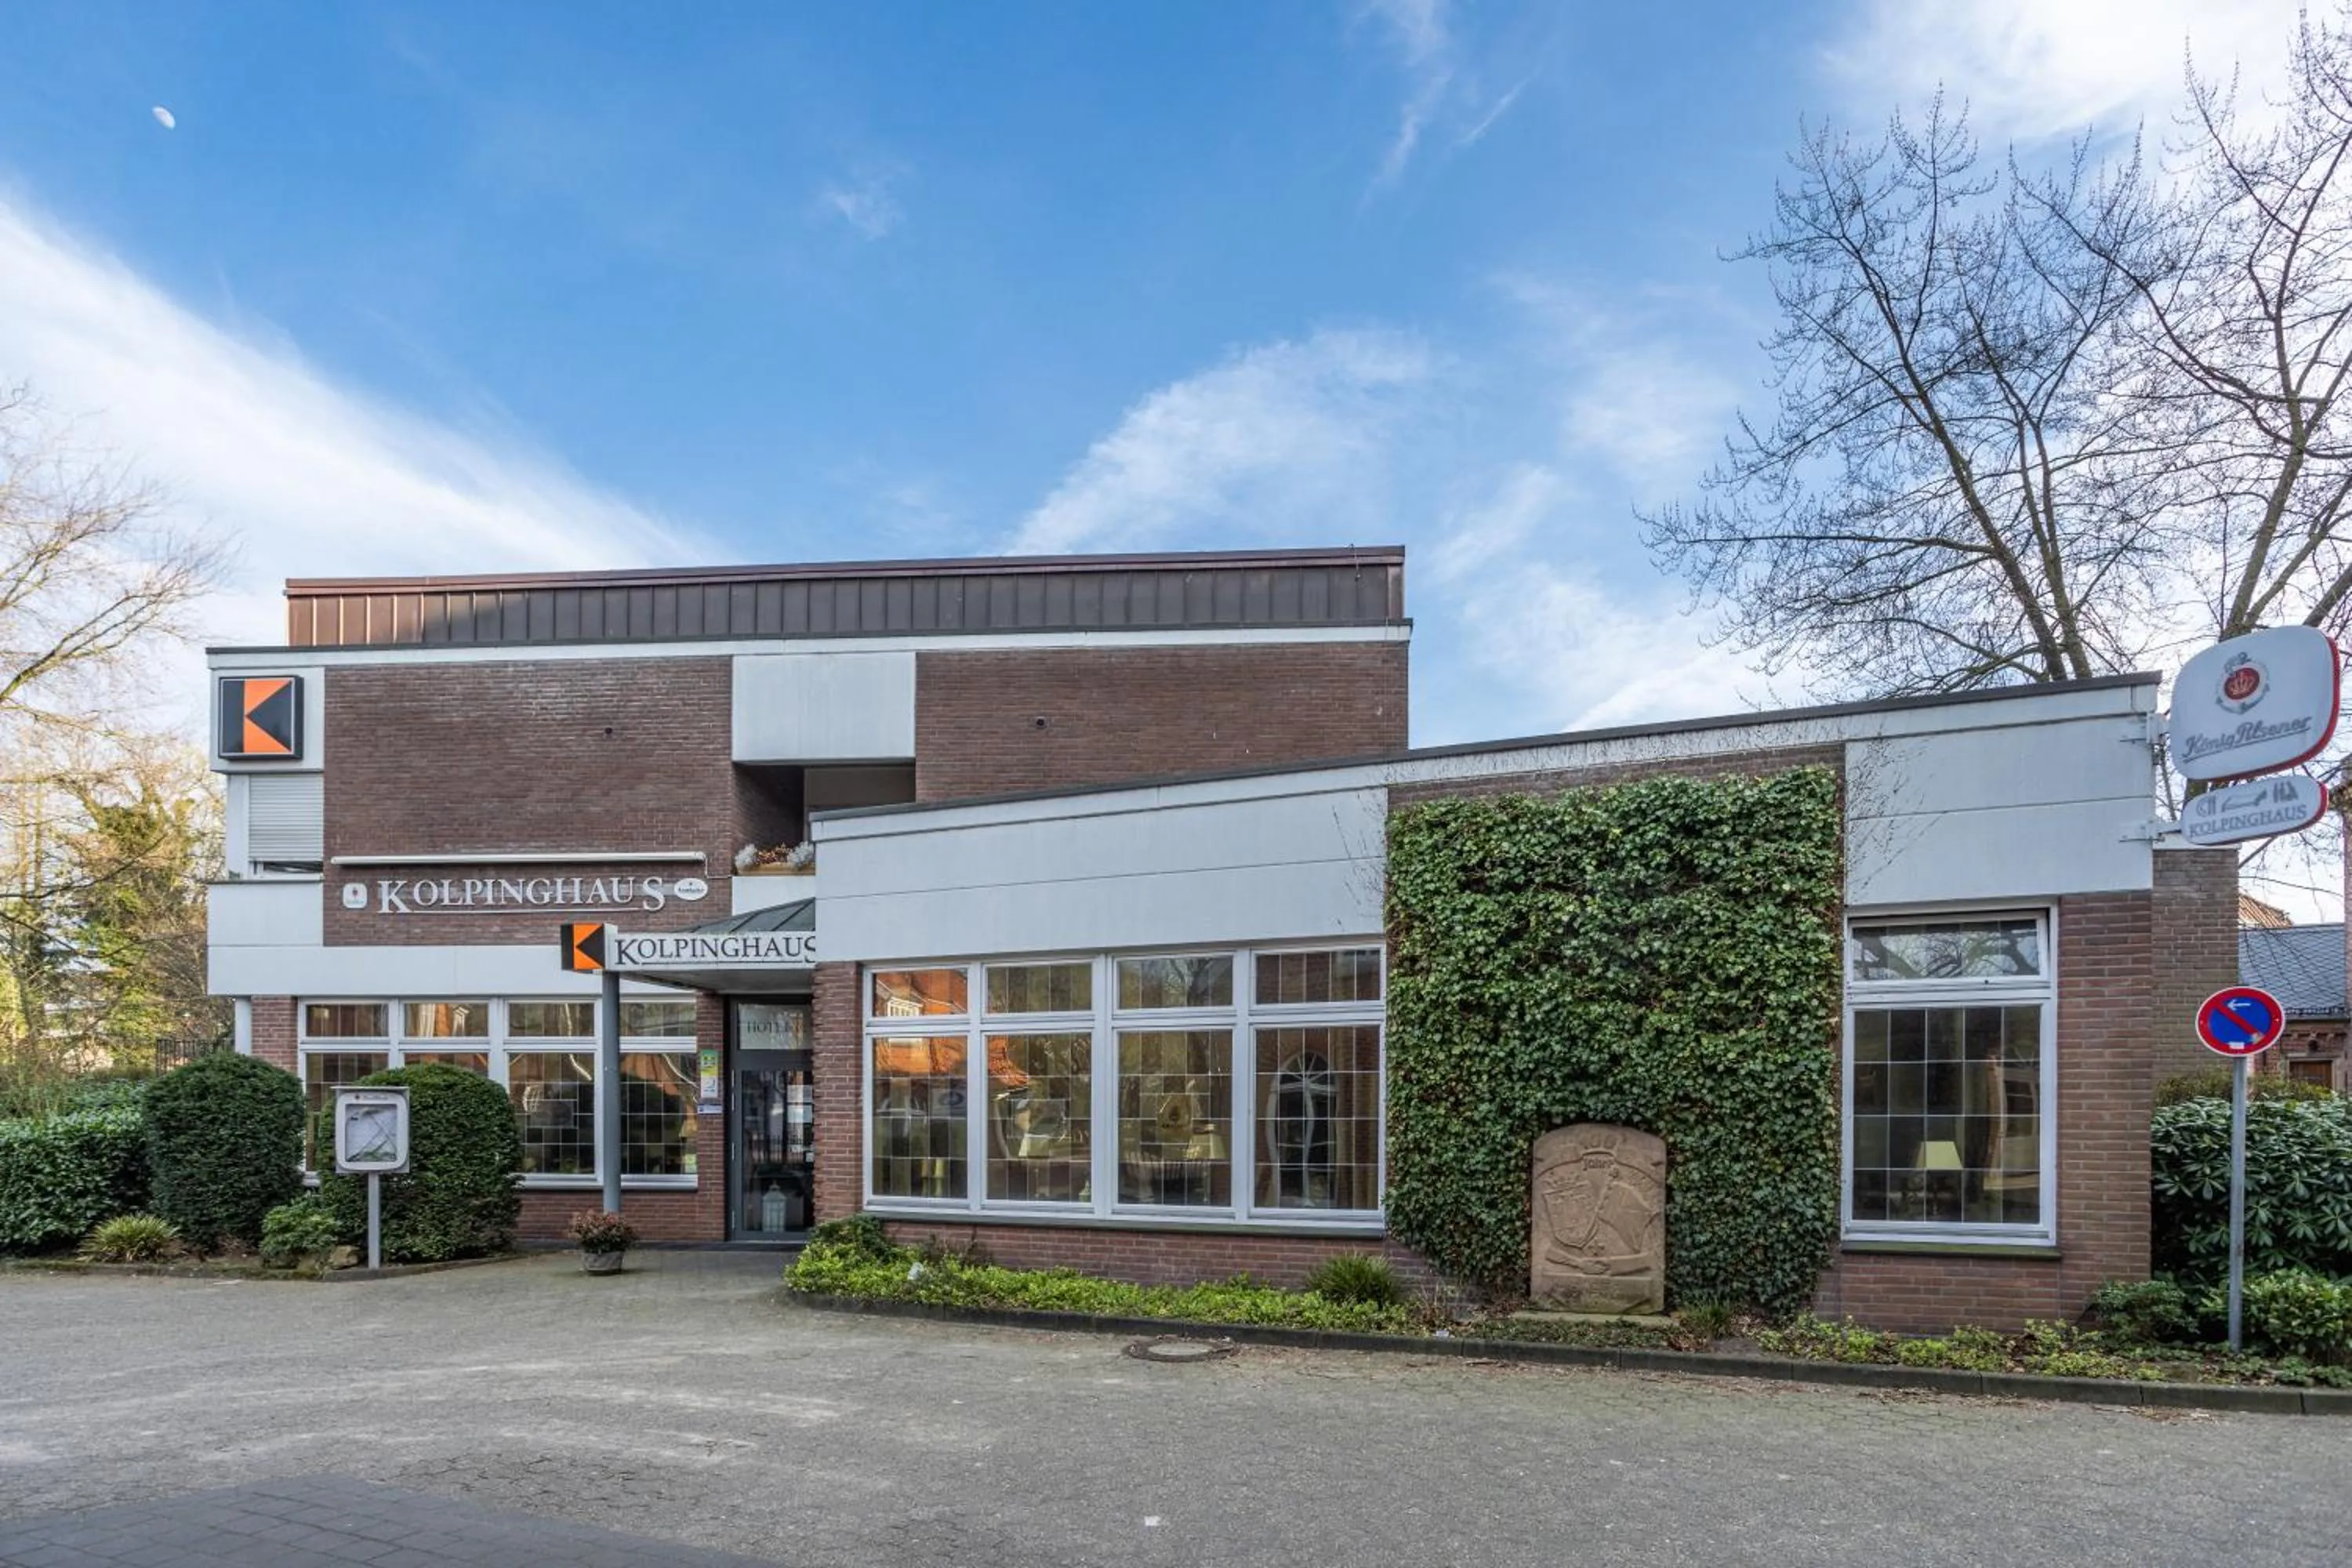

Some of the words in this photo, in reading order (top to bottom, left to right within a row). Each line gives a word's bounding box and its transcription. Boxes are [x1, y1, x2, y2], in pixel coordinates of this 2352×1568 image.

[2189, 804, 2307, 838] KOLPINGHAUS
[377, 876, 666, 913] KOLPINGHAUS
[615, 936, 816, 965] KOLPINGHAUS
